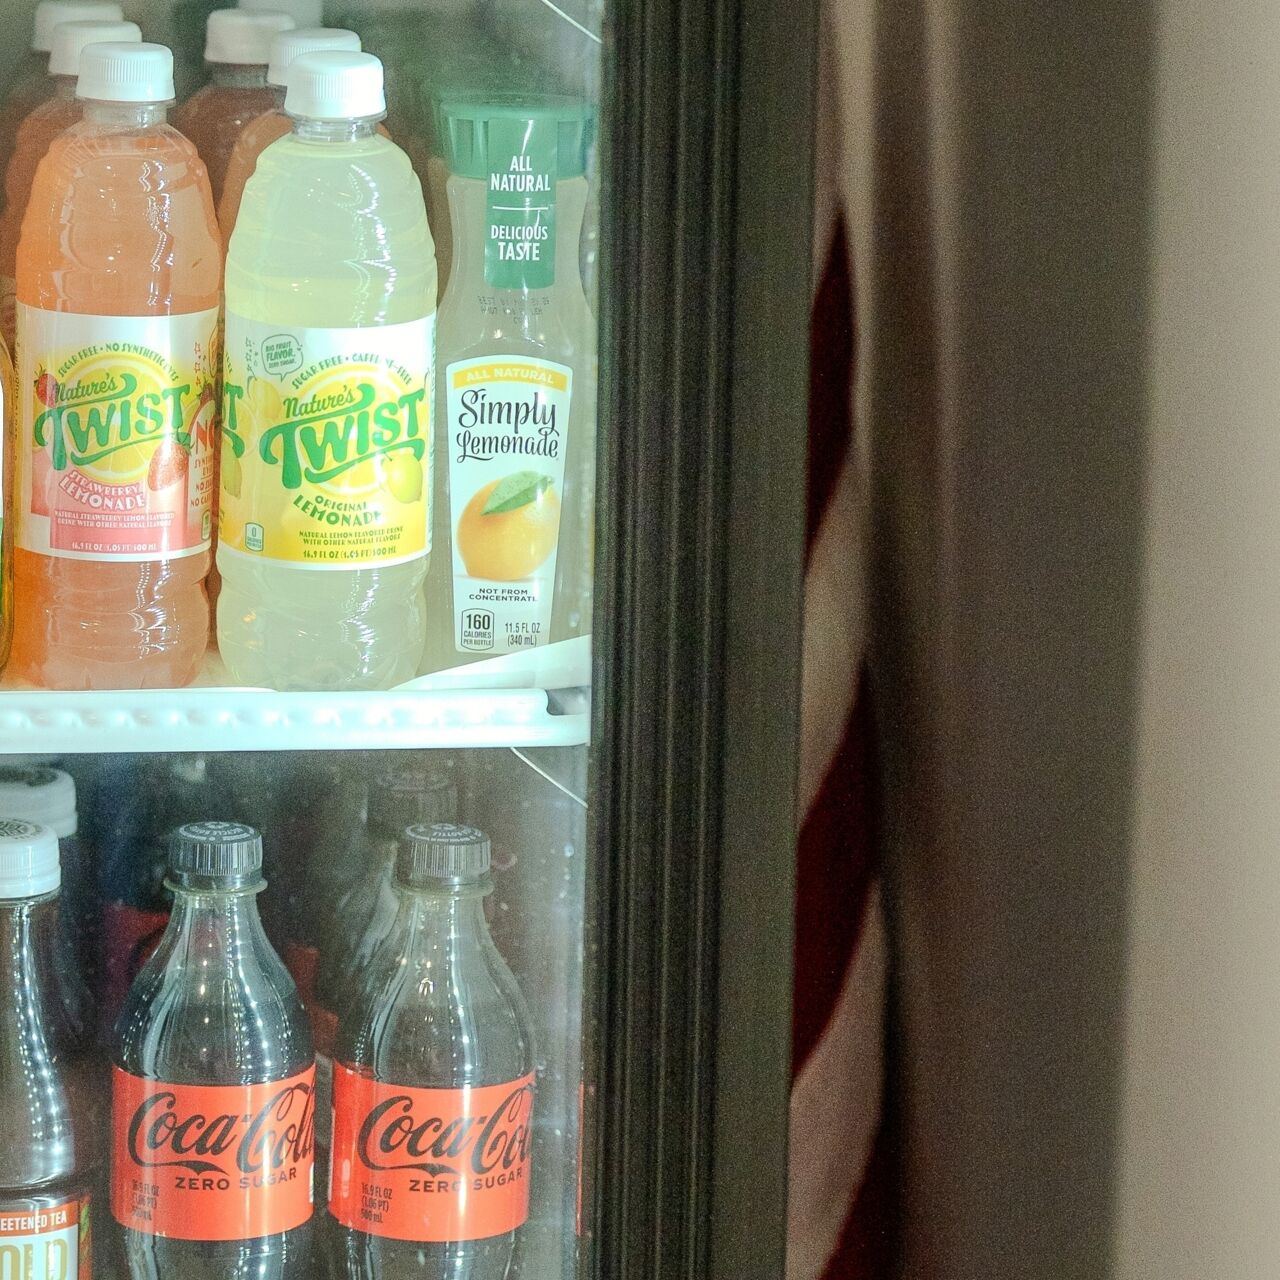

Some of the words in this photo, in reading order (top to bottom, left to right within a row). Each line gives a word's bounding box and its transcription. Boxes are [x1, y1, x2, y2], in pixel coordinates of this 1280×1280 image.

[509, 155, 532, 172] ALL
[490, 173, 551, 192] NATURAL
[490, 224, 549, 241] DELICIOUS
[497, 242, 541, 261] TASTE
[58, 355, 79, 378] SUGAR
[79, 345, 98, 360] FREE
[106, 342, 120, 352] NO
[122, 342, 166, 367] SYNTHETIC
[291, 366, 318, 389] SUGAR
[320, 355, 343, 371] FREE
[466, 369, 491, 382] ALL
[493, 367, 555, 385] NATURAL
[55, 372, 118, 401] Nature's
[283, 385, 356, 418] Nature's
[458, 388, 560, 437] Simply
[34, 382, 191, 473] TWIST
[259, 388, 427, 490] TWIST
[456, 429, 559, 464] Lemonade
[59, 477, 145, 510] LEMONADE
[466, 613, 491, 630] 160
[505, 622, 520, 634] 11.5
[521, 622, 530, 634] FL
[531, 622, 541, 634] OZ
[463, 630, 492, 638] CALORIES
[175, 1176, 230, 1191] ZERO
[239, 1167, 297, 1189] SUGAR
[473, 1167, 522, 1190] SUGAR
[50, 1210, 67, 1226] TEA
